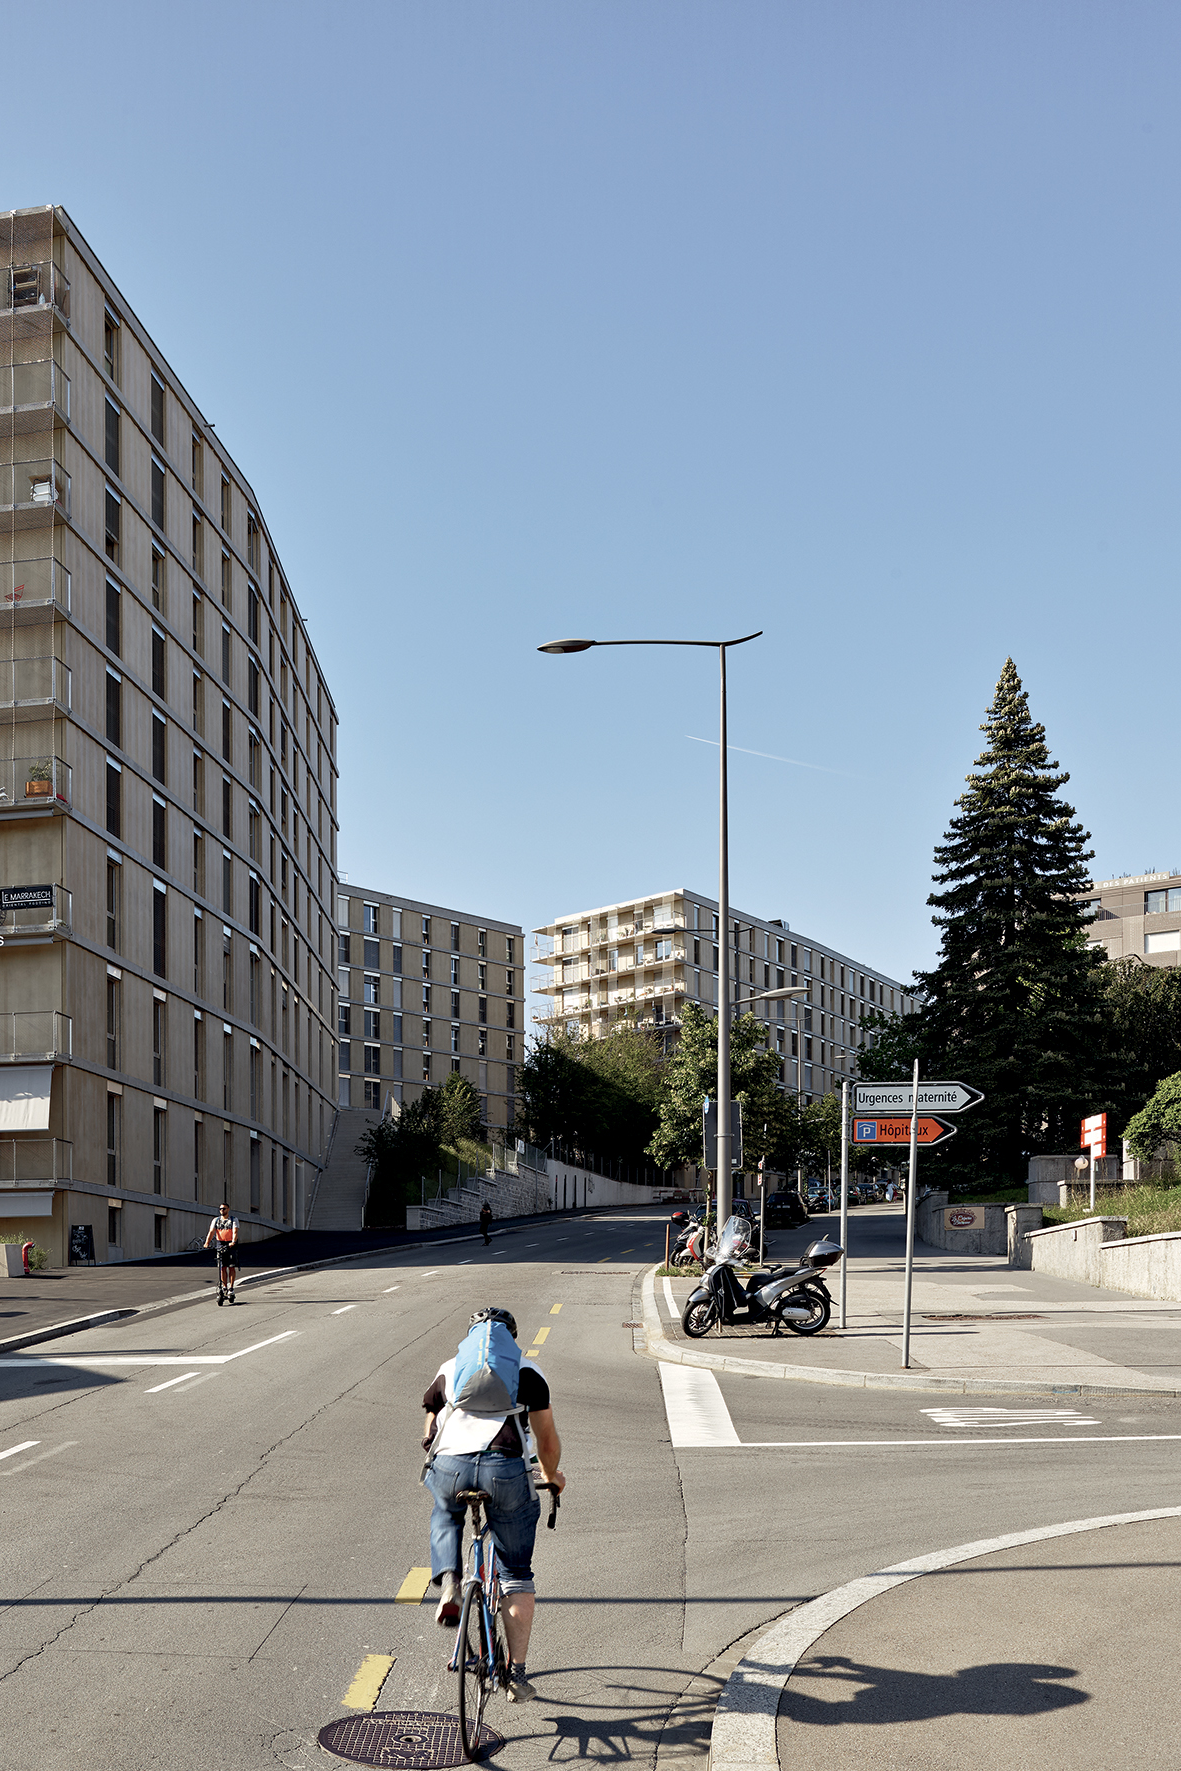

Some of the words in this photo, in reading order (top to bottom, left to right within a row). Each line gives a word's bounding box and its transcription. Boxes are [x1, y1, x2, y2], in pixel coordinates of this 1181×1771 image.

[1103, 880, 1120, 888] DES
[1123, 873, 1168, 886] PATIENTS
[10, 890, 51, 901] MARRAKECH
[858, 1092, 903, 1106] Urgences
[879, 1123, 929, 1139] Hôpitux
